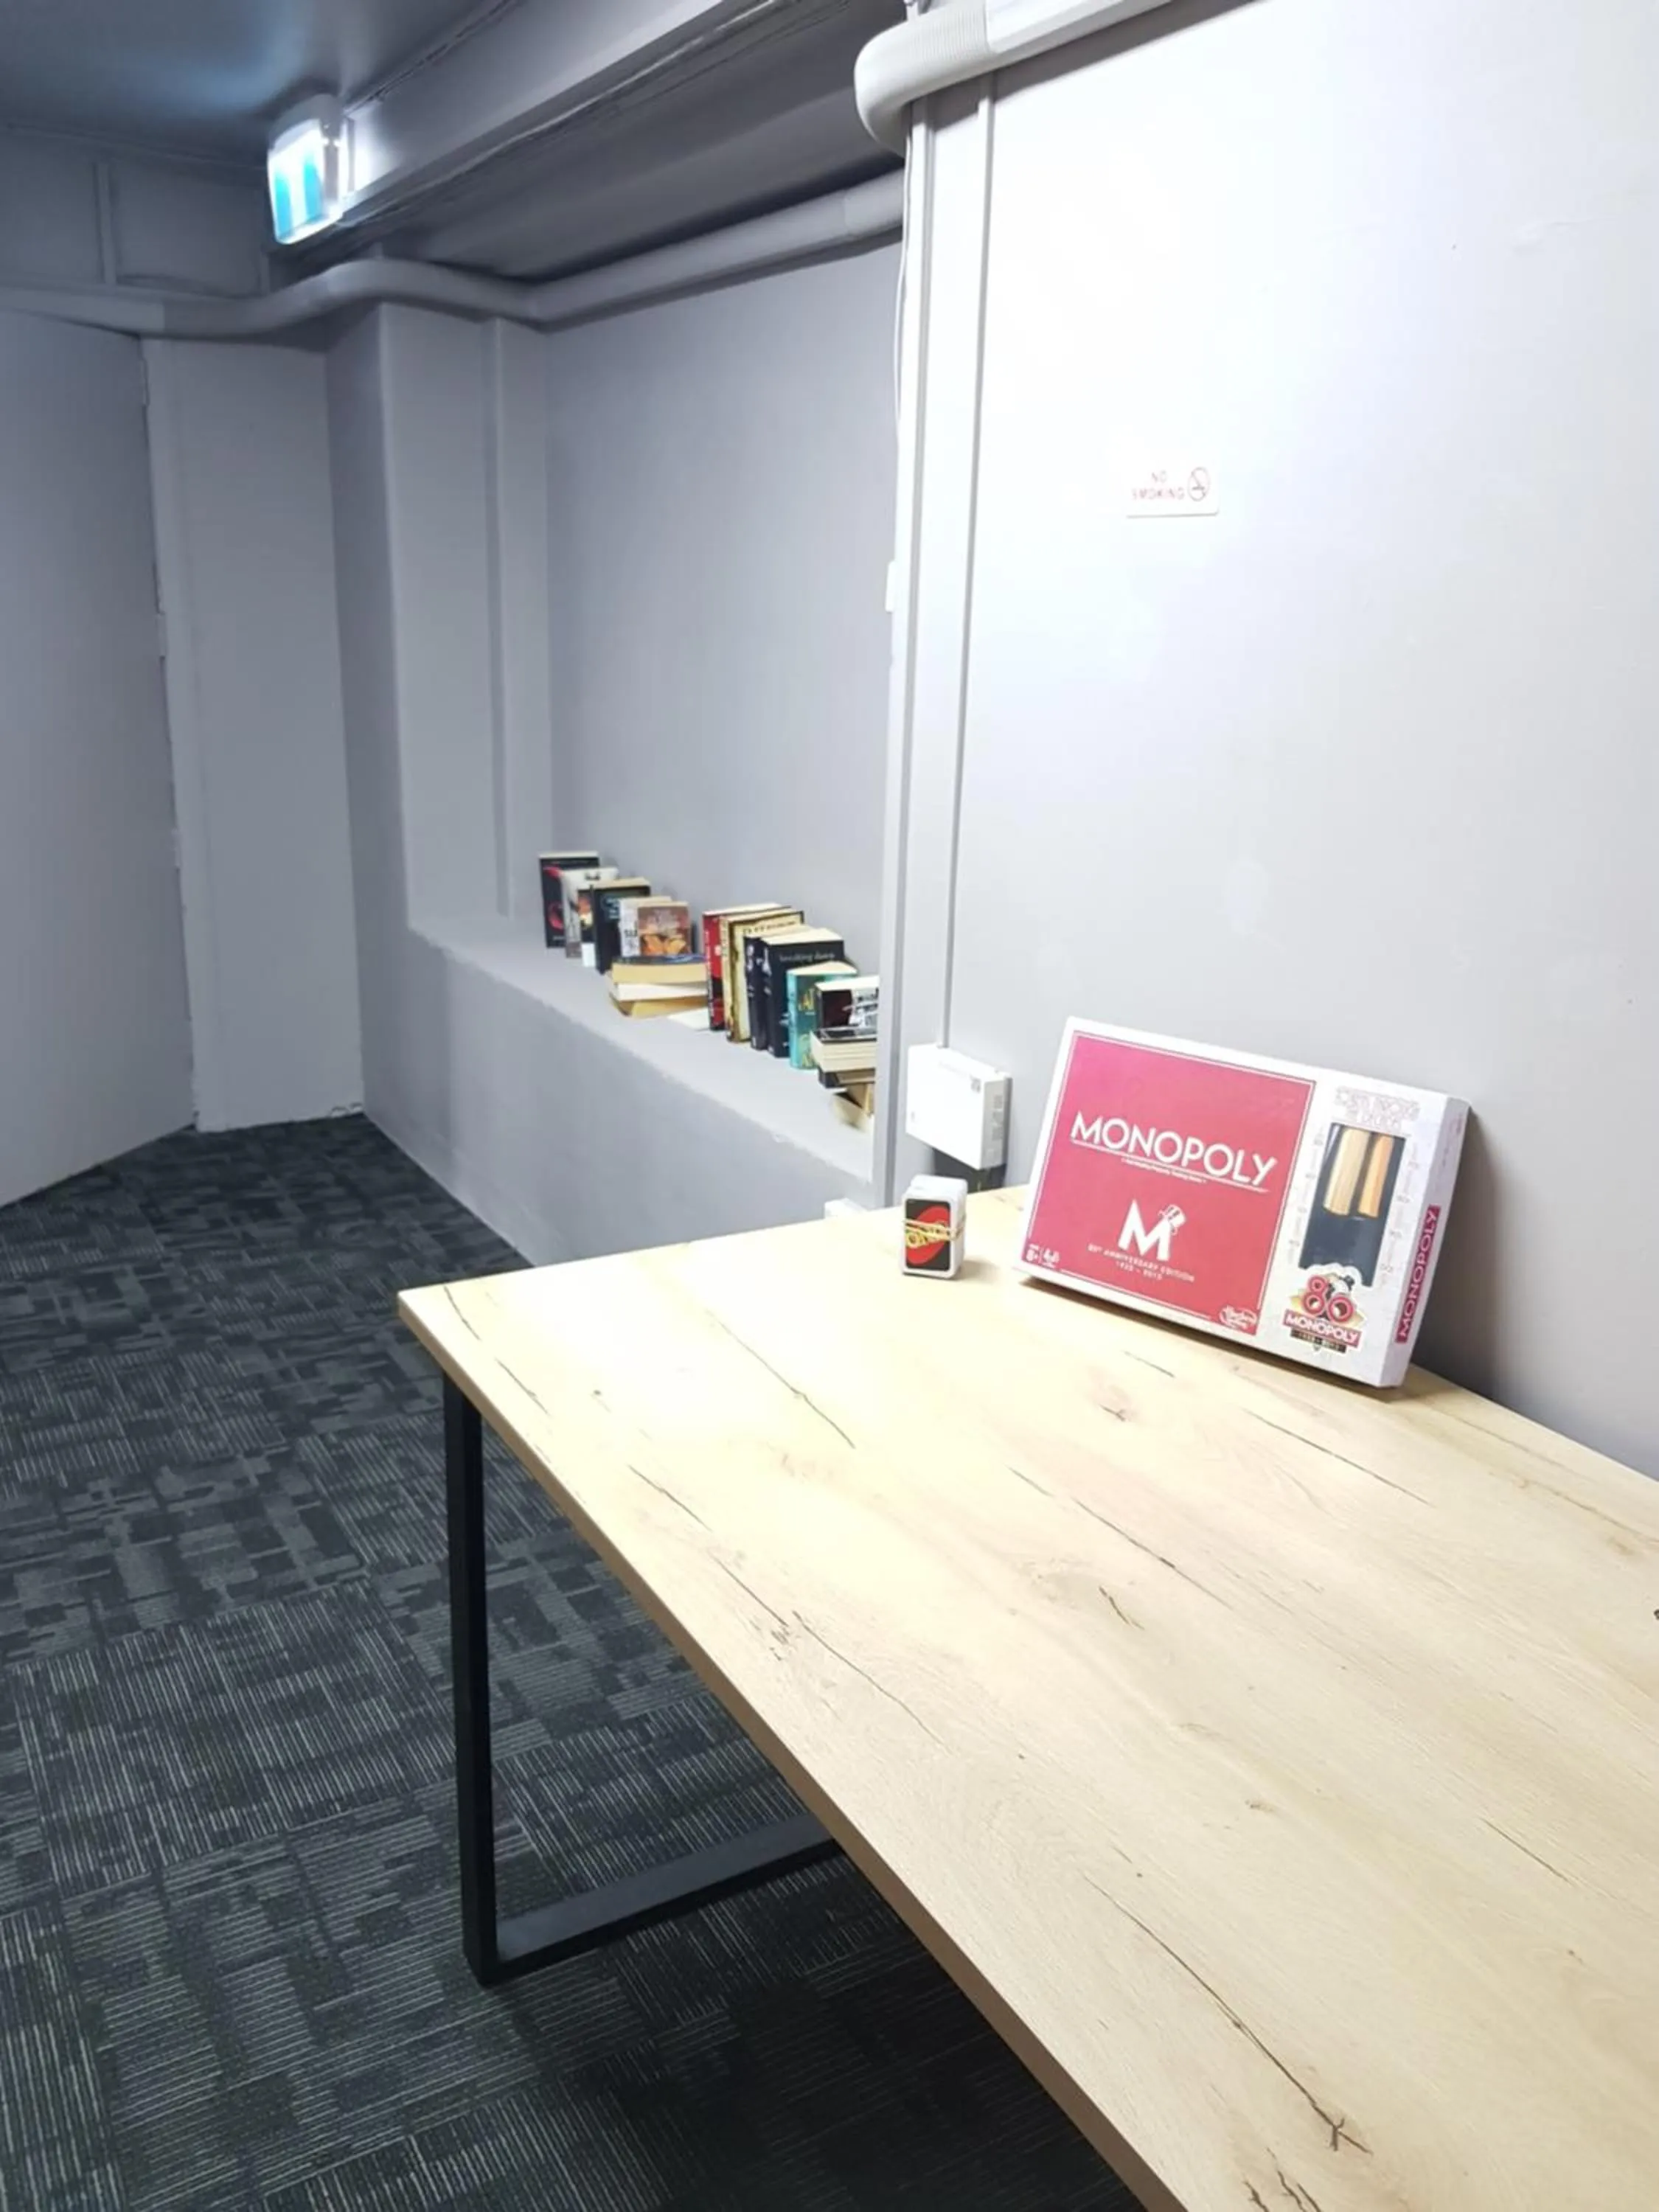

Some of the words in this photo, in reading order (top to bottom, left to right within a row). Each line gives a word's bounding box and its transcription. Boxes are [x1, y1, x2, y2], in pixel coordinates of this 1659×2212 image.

[1151, 470, 1168, 483] NO
[1131, 487, 1186, 501] SMOKING
[1071, 1110, 1278, 1186] MONOPOLY
[1398, 1209, 1437, 1337] MONOPOLY
[1284, 1312, 1358, 1344] MONOPOLY
